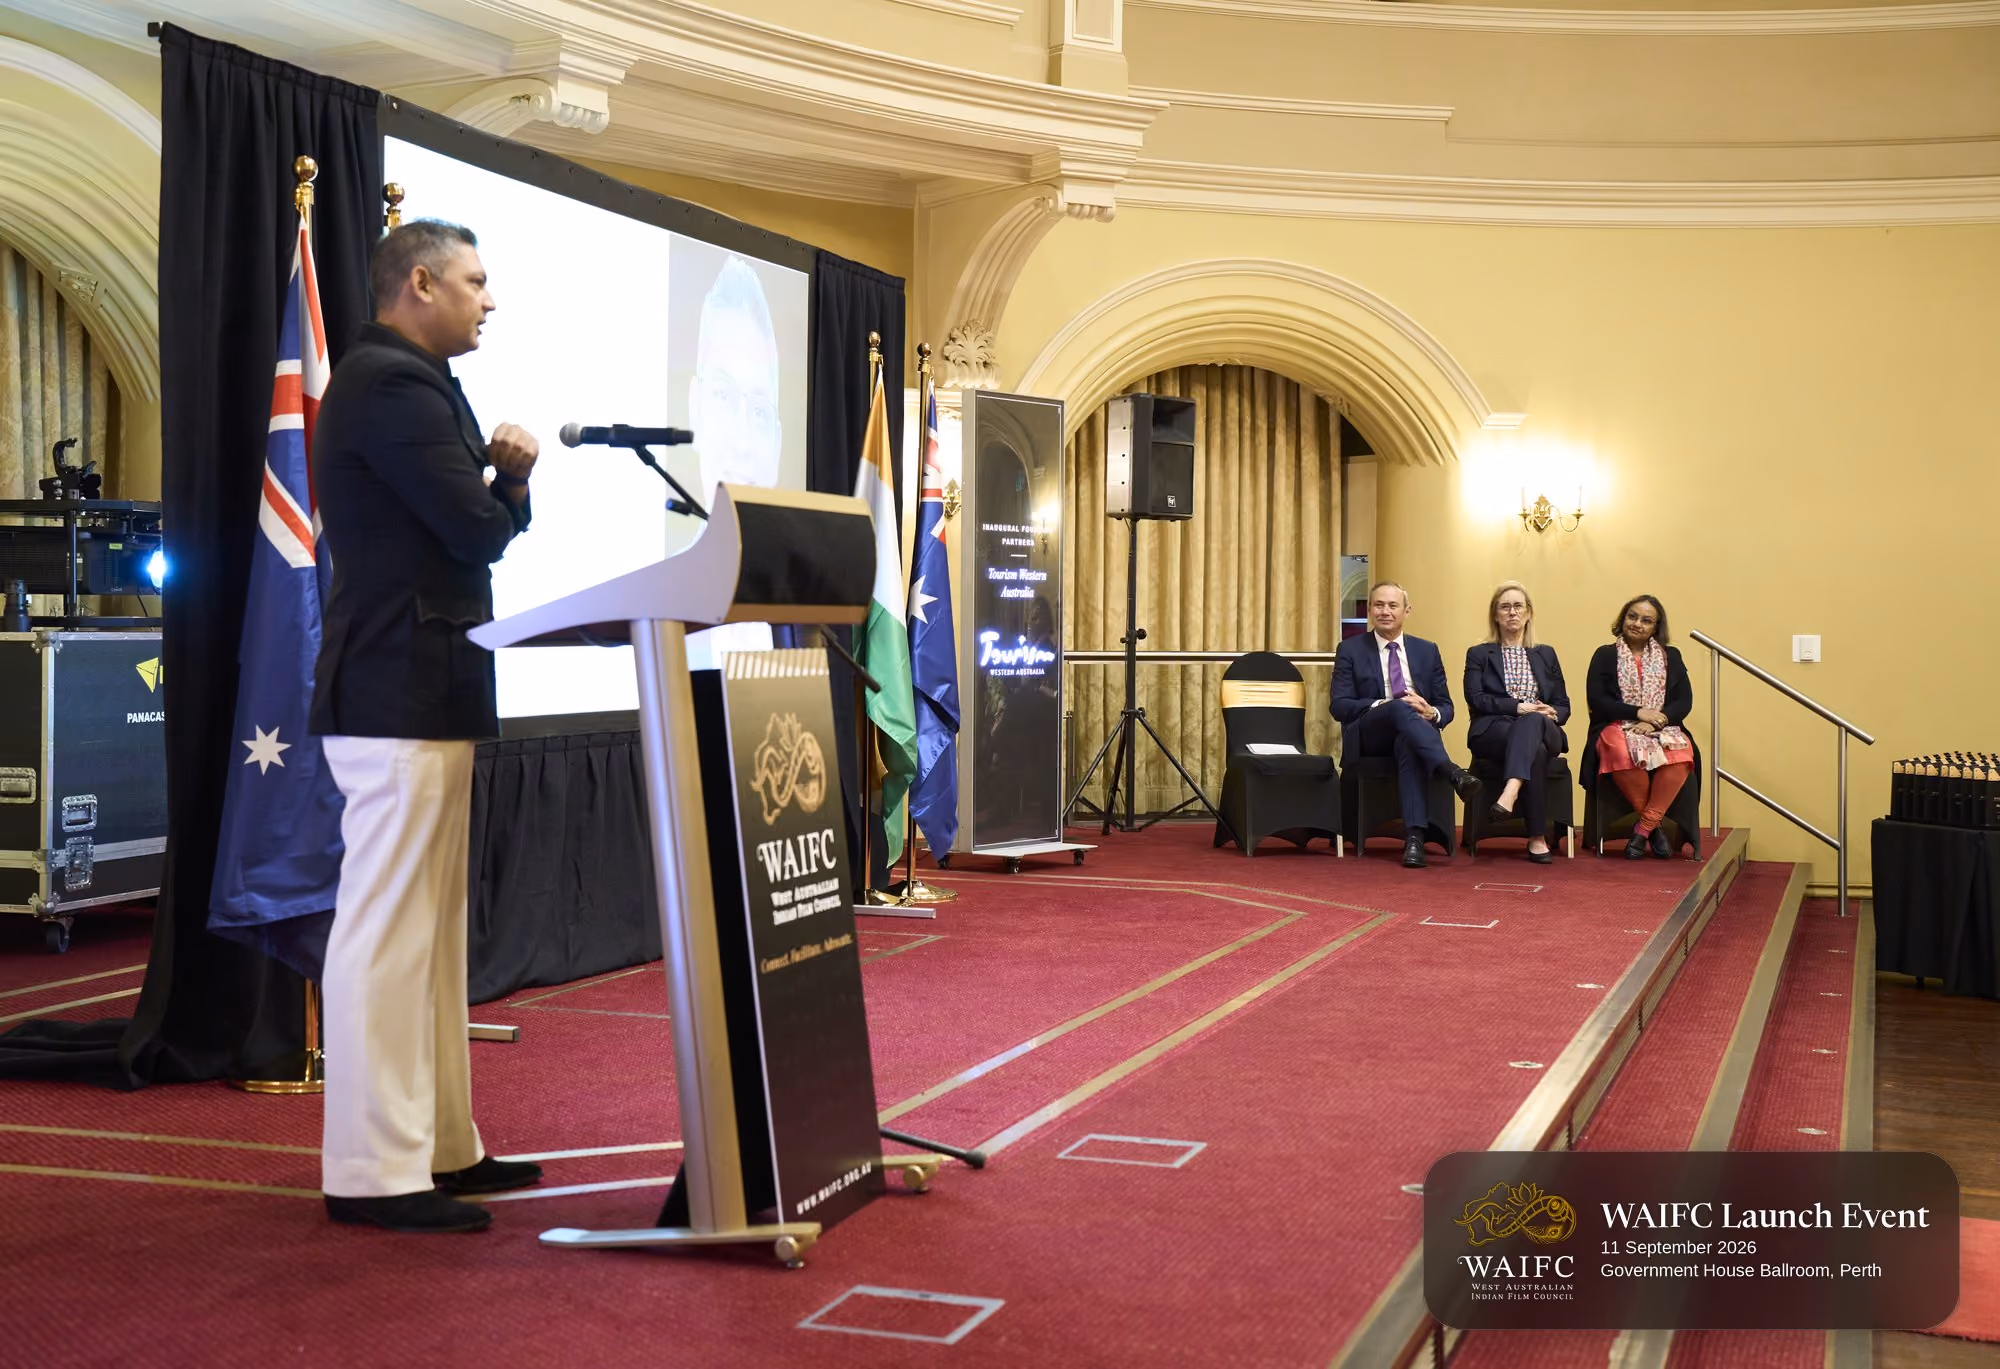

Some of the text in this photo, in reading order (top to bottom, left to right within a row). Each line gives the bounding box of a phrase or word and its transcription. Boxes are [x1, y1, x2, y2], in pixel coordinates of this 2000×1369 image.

[982, 523, 1020, 533] INAUGURAL
[1001, 537, 1035, 546] PARTNERS
[988, 567, 1047, 580] Tourism Western
[1000, 585, 1035, 598] Australia
[756, 828, 837, 884] WAIFC
